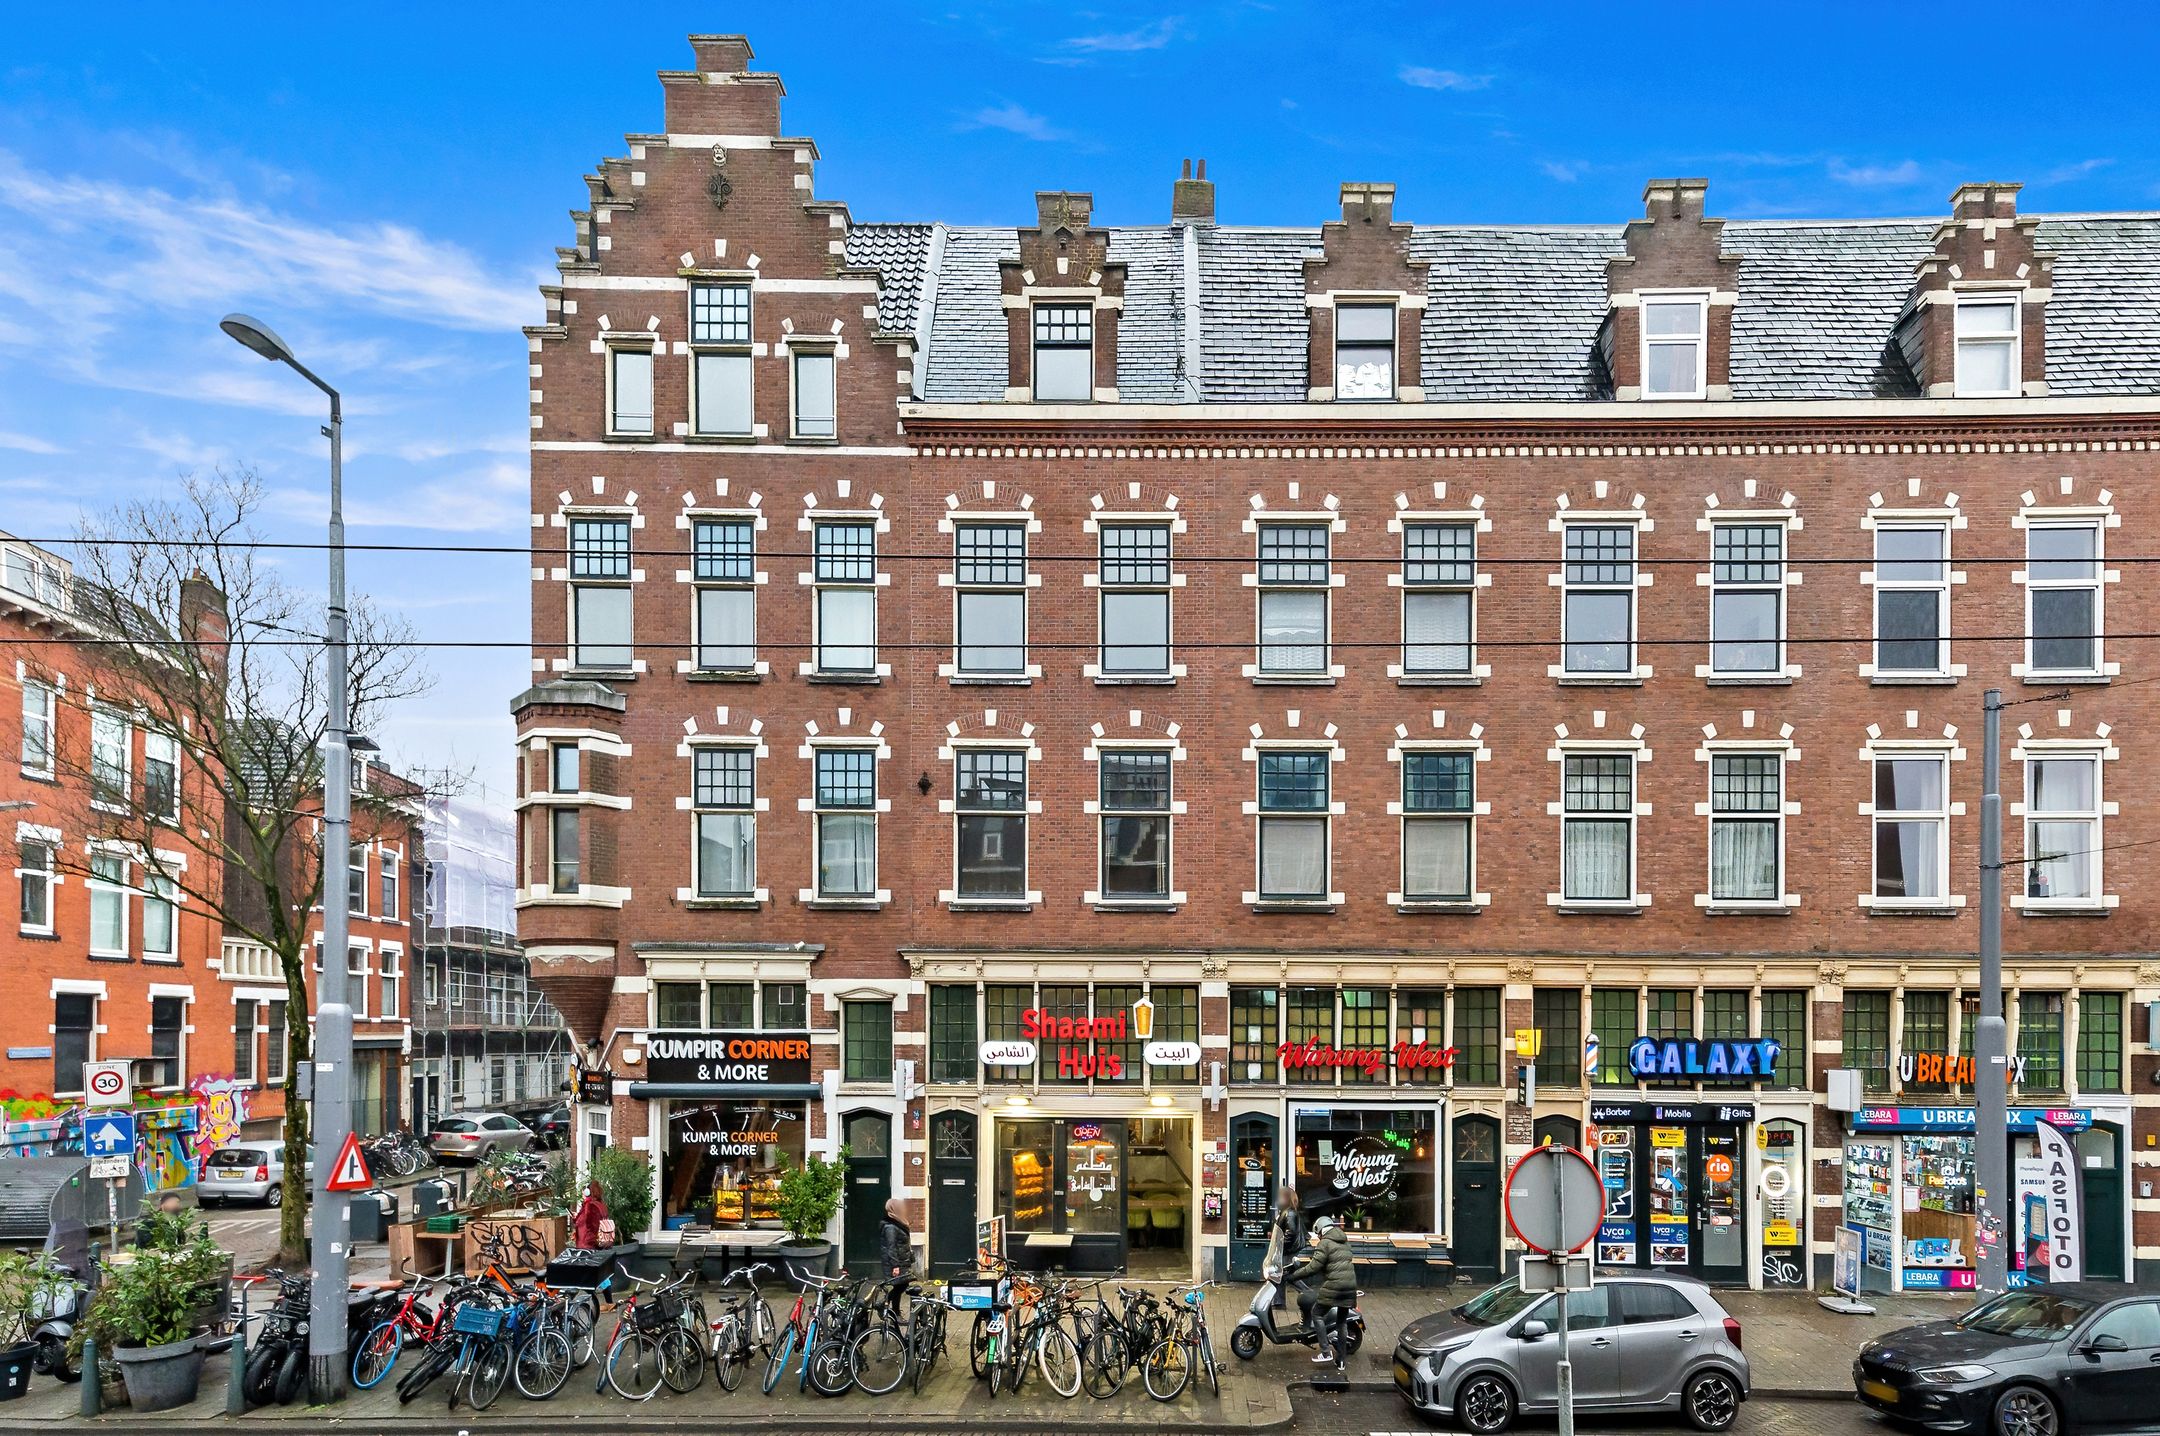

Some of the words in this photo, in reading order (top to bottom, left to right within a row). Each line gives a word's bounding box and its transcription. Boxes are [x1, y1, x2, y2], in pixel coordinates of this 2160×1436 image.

[1022, 1008, 1126, 1040] Shaami
[647, 1039, 726, 1060] KUMPIR
[728, 1040, 810, 1060] CORNER
[986, 1045, 1030, 1064] الشامي
[1155, 1046, 1190, 1062] البيت
[1276, 1035, 1386, 1075] Warung
[1394, 1040, 1461, 1068] West
[1060, 1046, 1122, 1078] Huis
[1638, 1042, 1778, 1076] GALAXY
[698, 1064, 710, 1080] &
[715, 1064, 768, 1080] MORE
[1900, 1056, 1914, 1082] U
[98, 1078, 118, 1088] 30
[1606, 1108, 1631, 1116] Barber
[1664, 1109, 1692, 1118] Mobile
[1732, 1109, 1752, 1118] Gifts
[1924, 1111, 1936, 1122] U
[1938, 1111, 1975, 1122] BREA
[2053, 1112, 2086, 1120] LEBARA
[682, 1132, 728, 1143] KUMPIR
[730, 1132, 778, 1143] CORNER
[1074, 1127, 1100, 1137] OPEN
[1601, 1133, 1628, 1144] OPEN
[710, 1145, 718, 1155] &
[721, 1145, 757, 1156] MORE
[1331, 1148, 1398, 1172] Warung
[1710, 1158, 1729, 1172] ria
[1349, 1168, 1390, 1187] West
[1602, 1226, 1624, 1236] Lyca
[1654, 1226, 1670, 1234] Lyca
[1906, 1273, 1939, 1281] LEBARA
